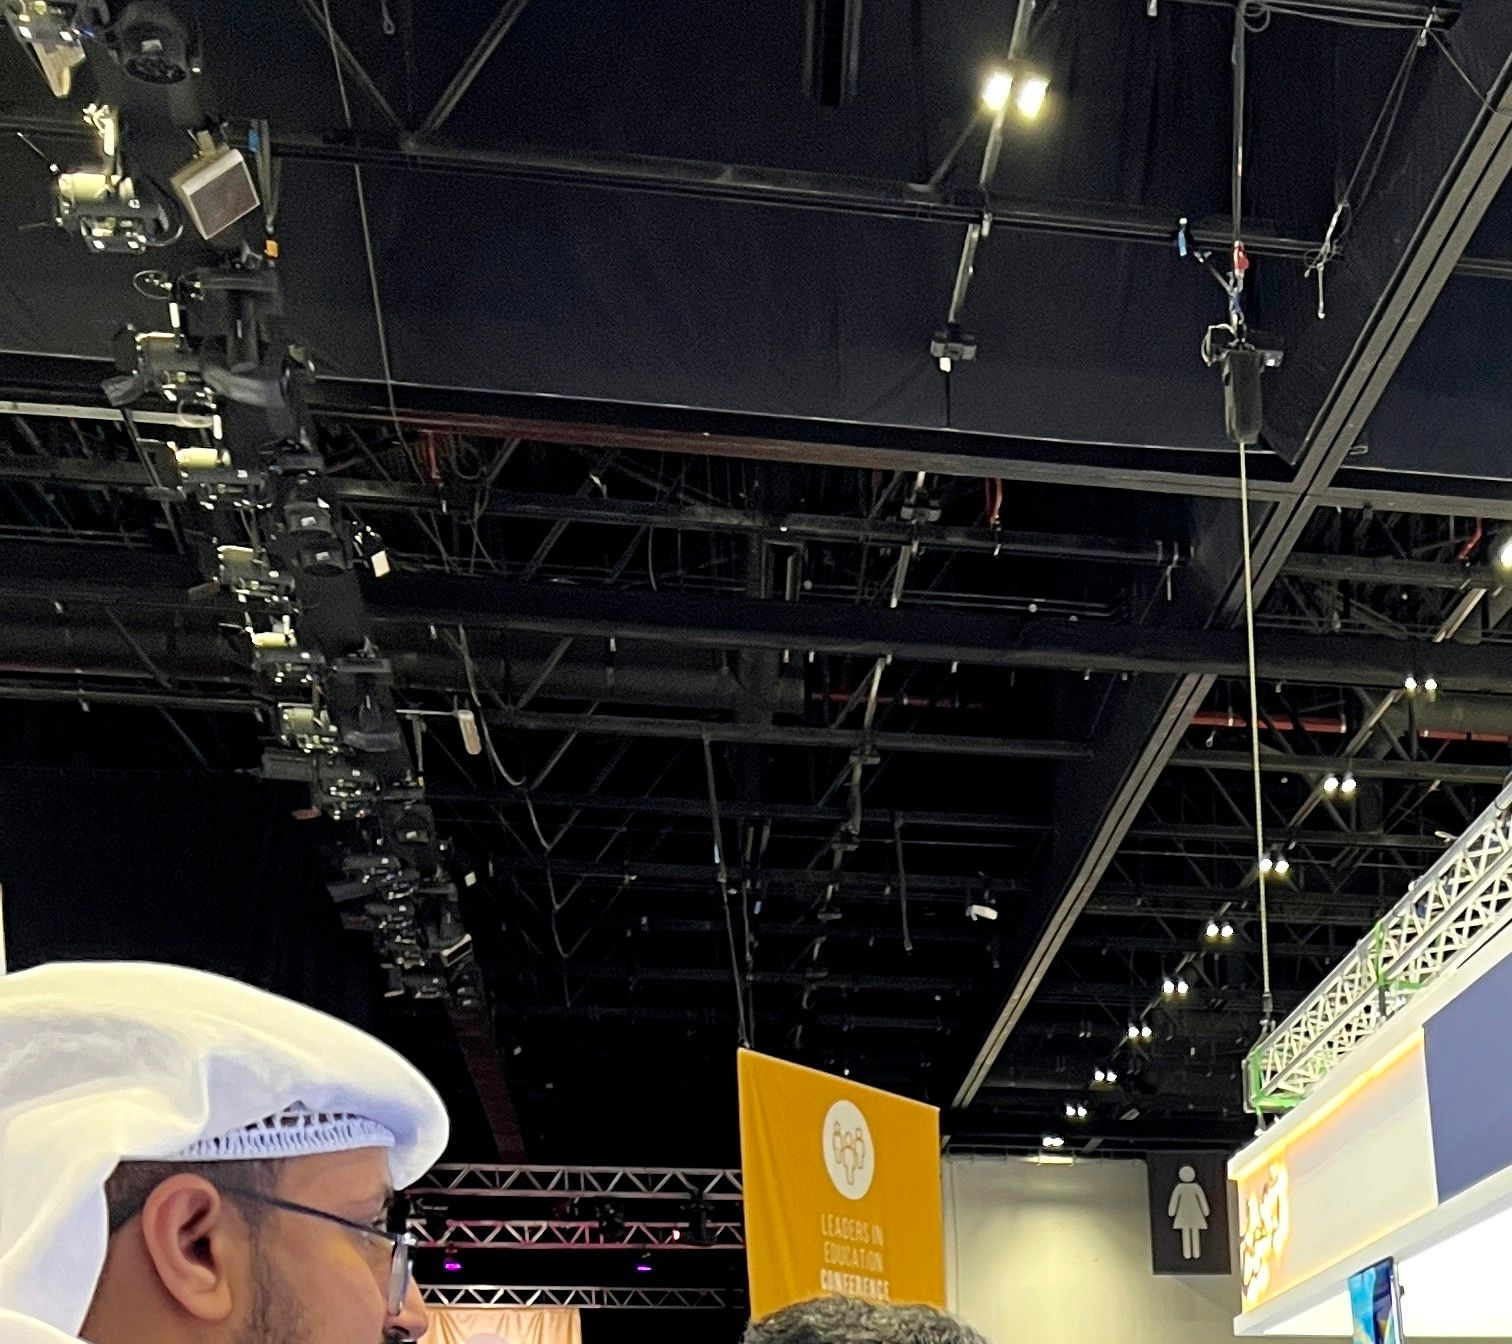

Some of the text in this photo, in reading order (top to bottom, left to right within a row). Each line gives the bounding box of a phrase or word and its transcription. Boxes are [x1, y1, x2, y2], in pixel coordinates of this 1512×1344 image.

[821, 1213, 884, 1246] LEADERS IN
[824, 1241, 883, 1272] EDUCATION
[821, 1269, 889, 1301] CONFERENCE
